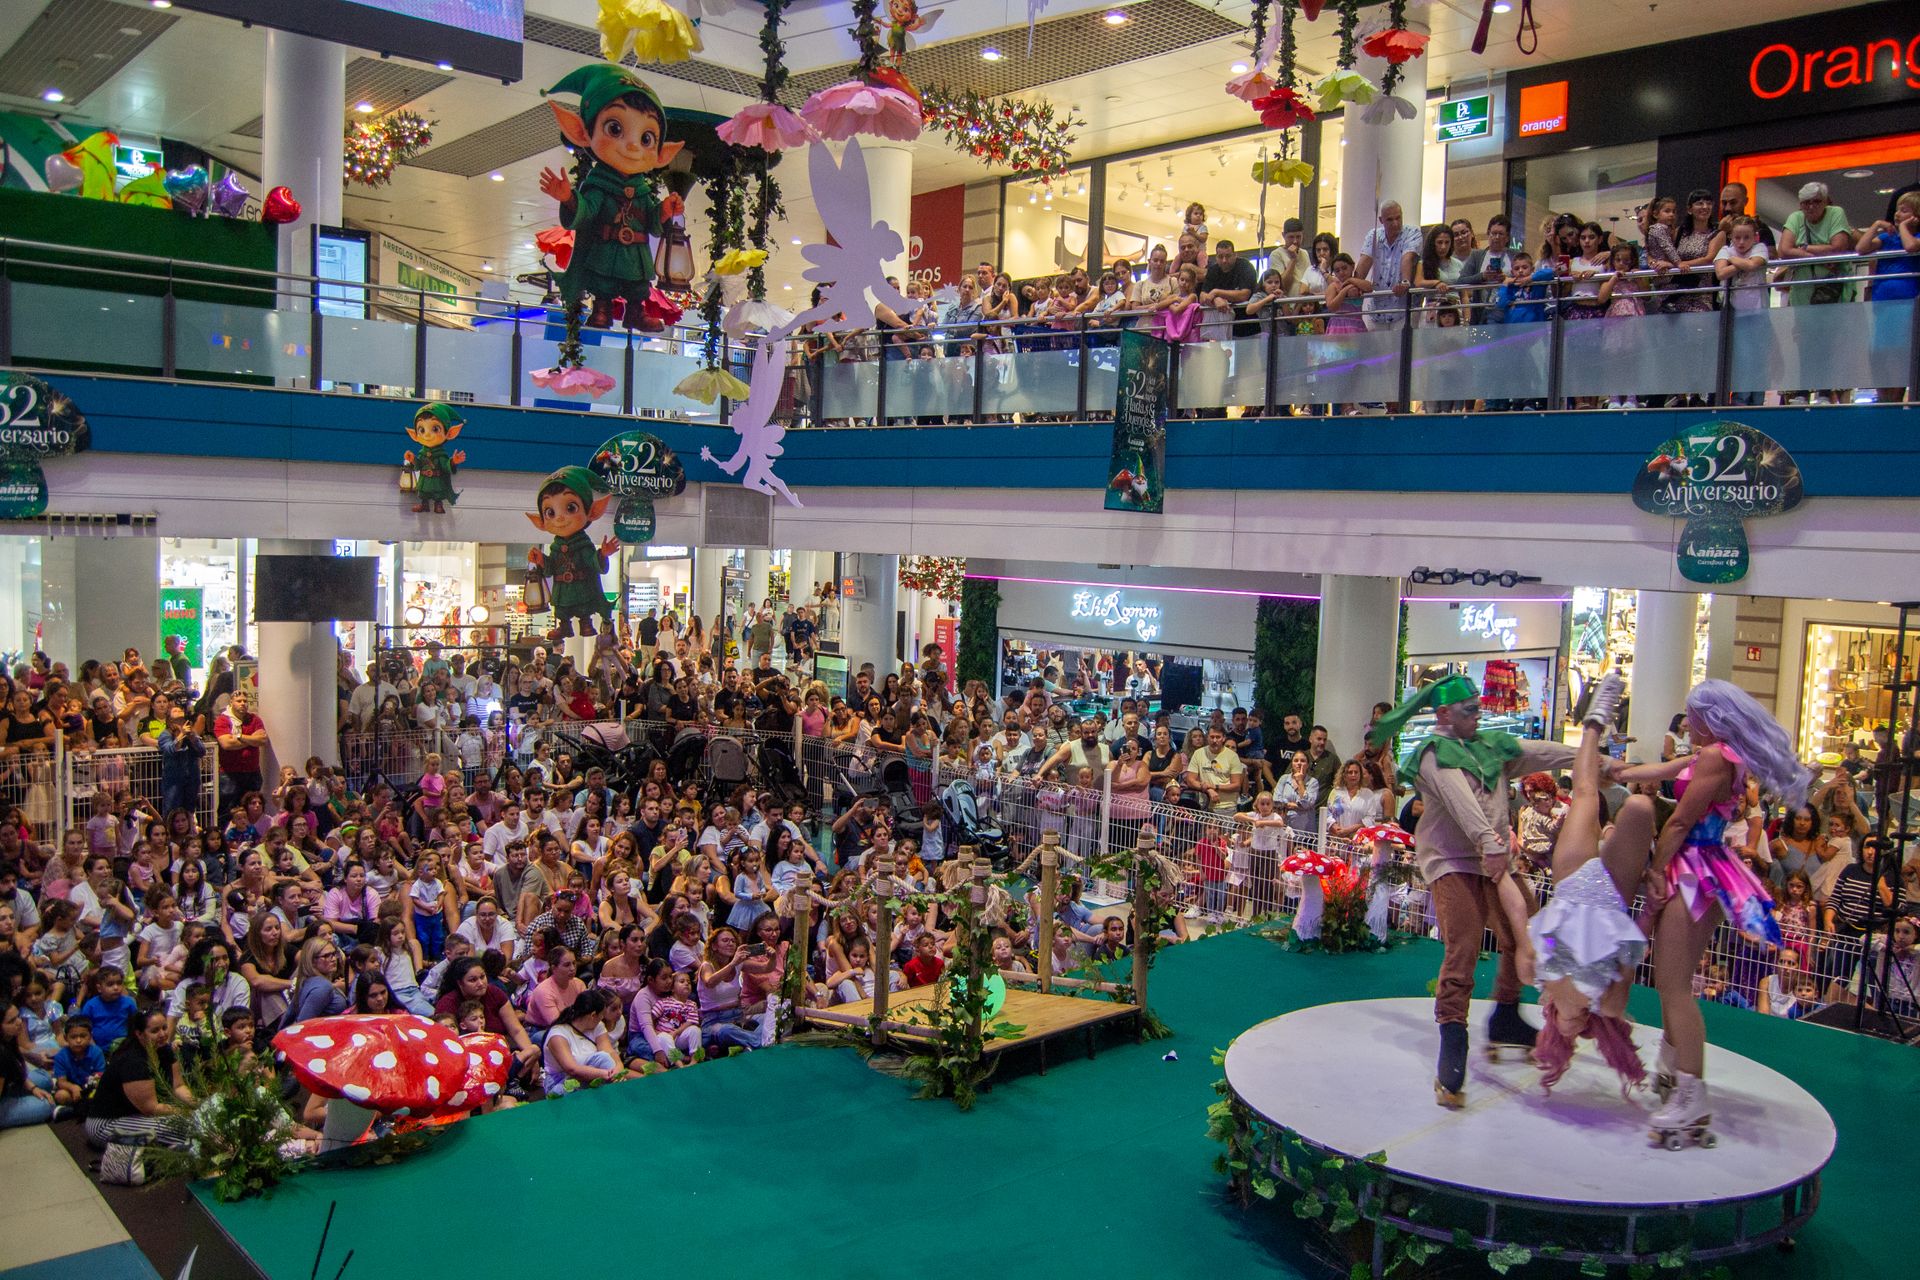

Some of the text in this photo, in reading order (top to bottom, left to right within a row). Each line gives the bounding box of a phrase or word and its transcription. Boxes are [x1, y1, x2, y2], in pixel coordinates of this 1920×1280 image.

[383, 240, 413, 260] ARREGLOS
[419, 257, 471, 287] TRANSFORMACIONES
[1126, 369, 1146, 399] 32
[621, 439, 656, 474] 32
[1686, 435, 1747, 482] 32
[602, 471, 673, 494] Aniversario
[1654, 481, 1778, 512] Aniversario
[165, 600, 186, 610] ALE
[1280, 749, 1295, 759] VA
